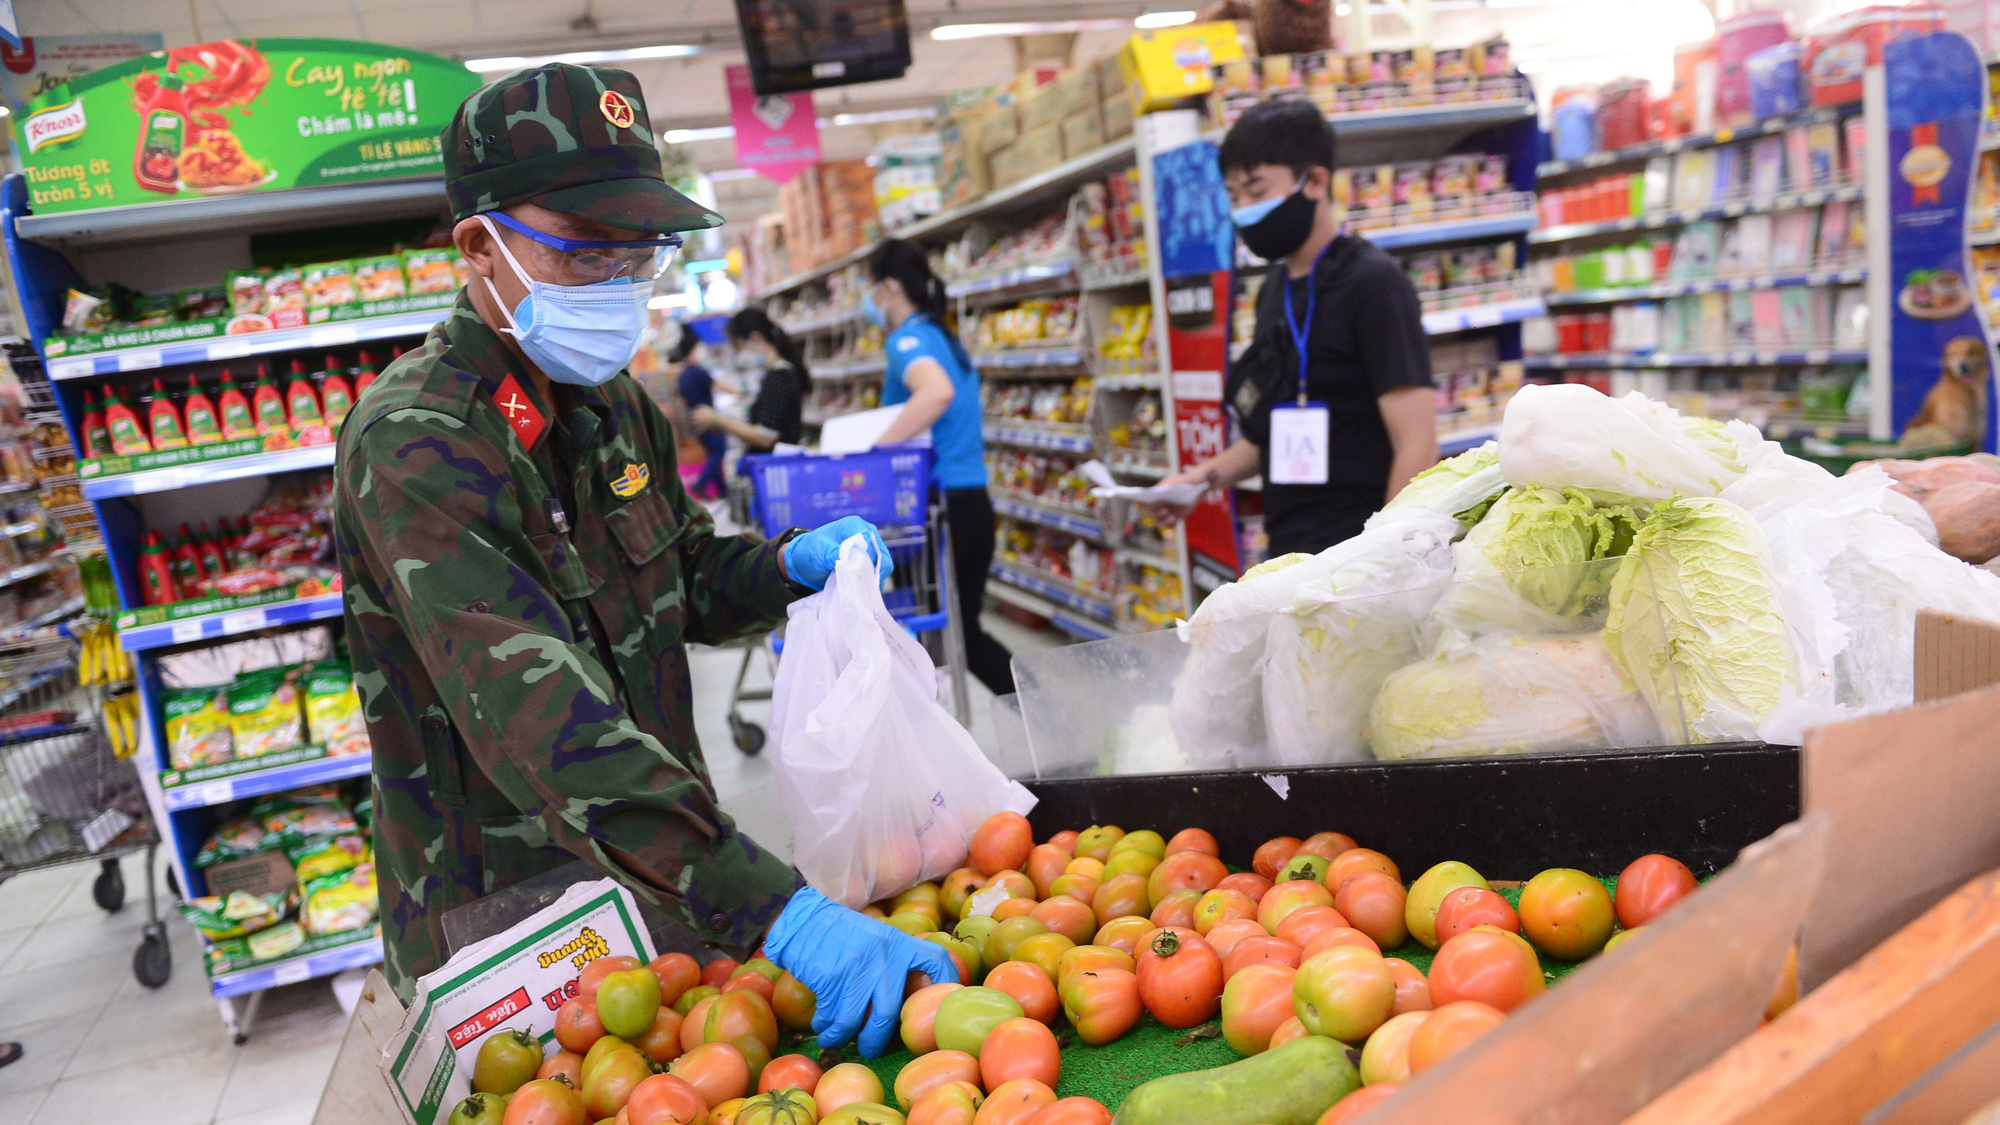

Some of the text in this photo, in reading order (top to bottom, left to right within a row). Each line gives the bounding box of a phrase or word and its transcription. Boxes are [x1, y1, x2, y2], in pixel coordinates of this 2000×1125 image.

[285, 56, 412, 96] Cay ngon
[29, 111, 82, 141] Knorr
[24, 157, 112, 184] Tương ớt
[33, 178, 114, 205] tròn 5 vị
[453, 1019, 486, 1042] Tiệc
